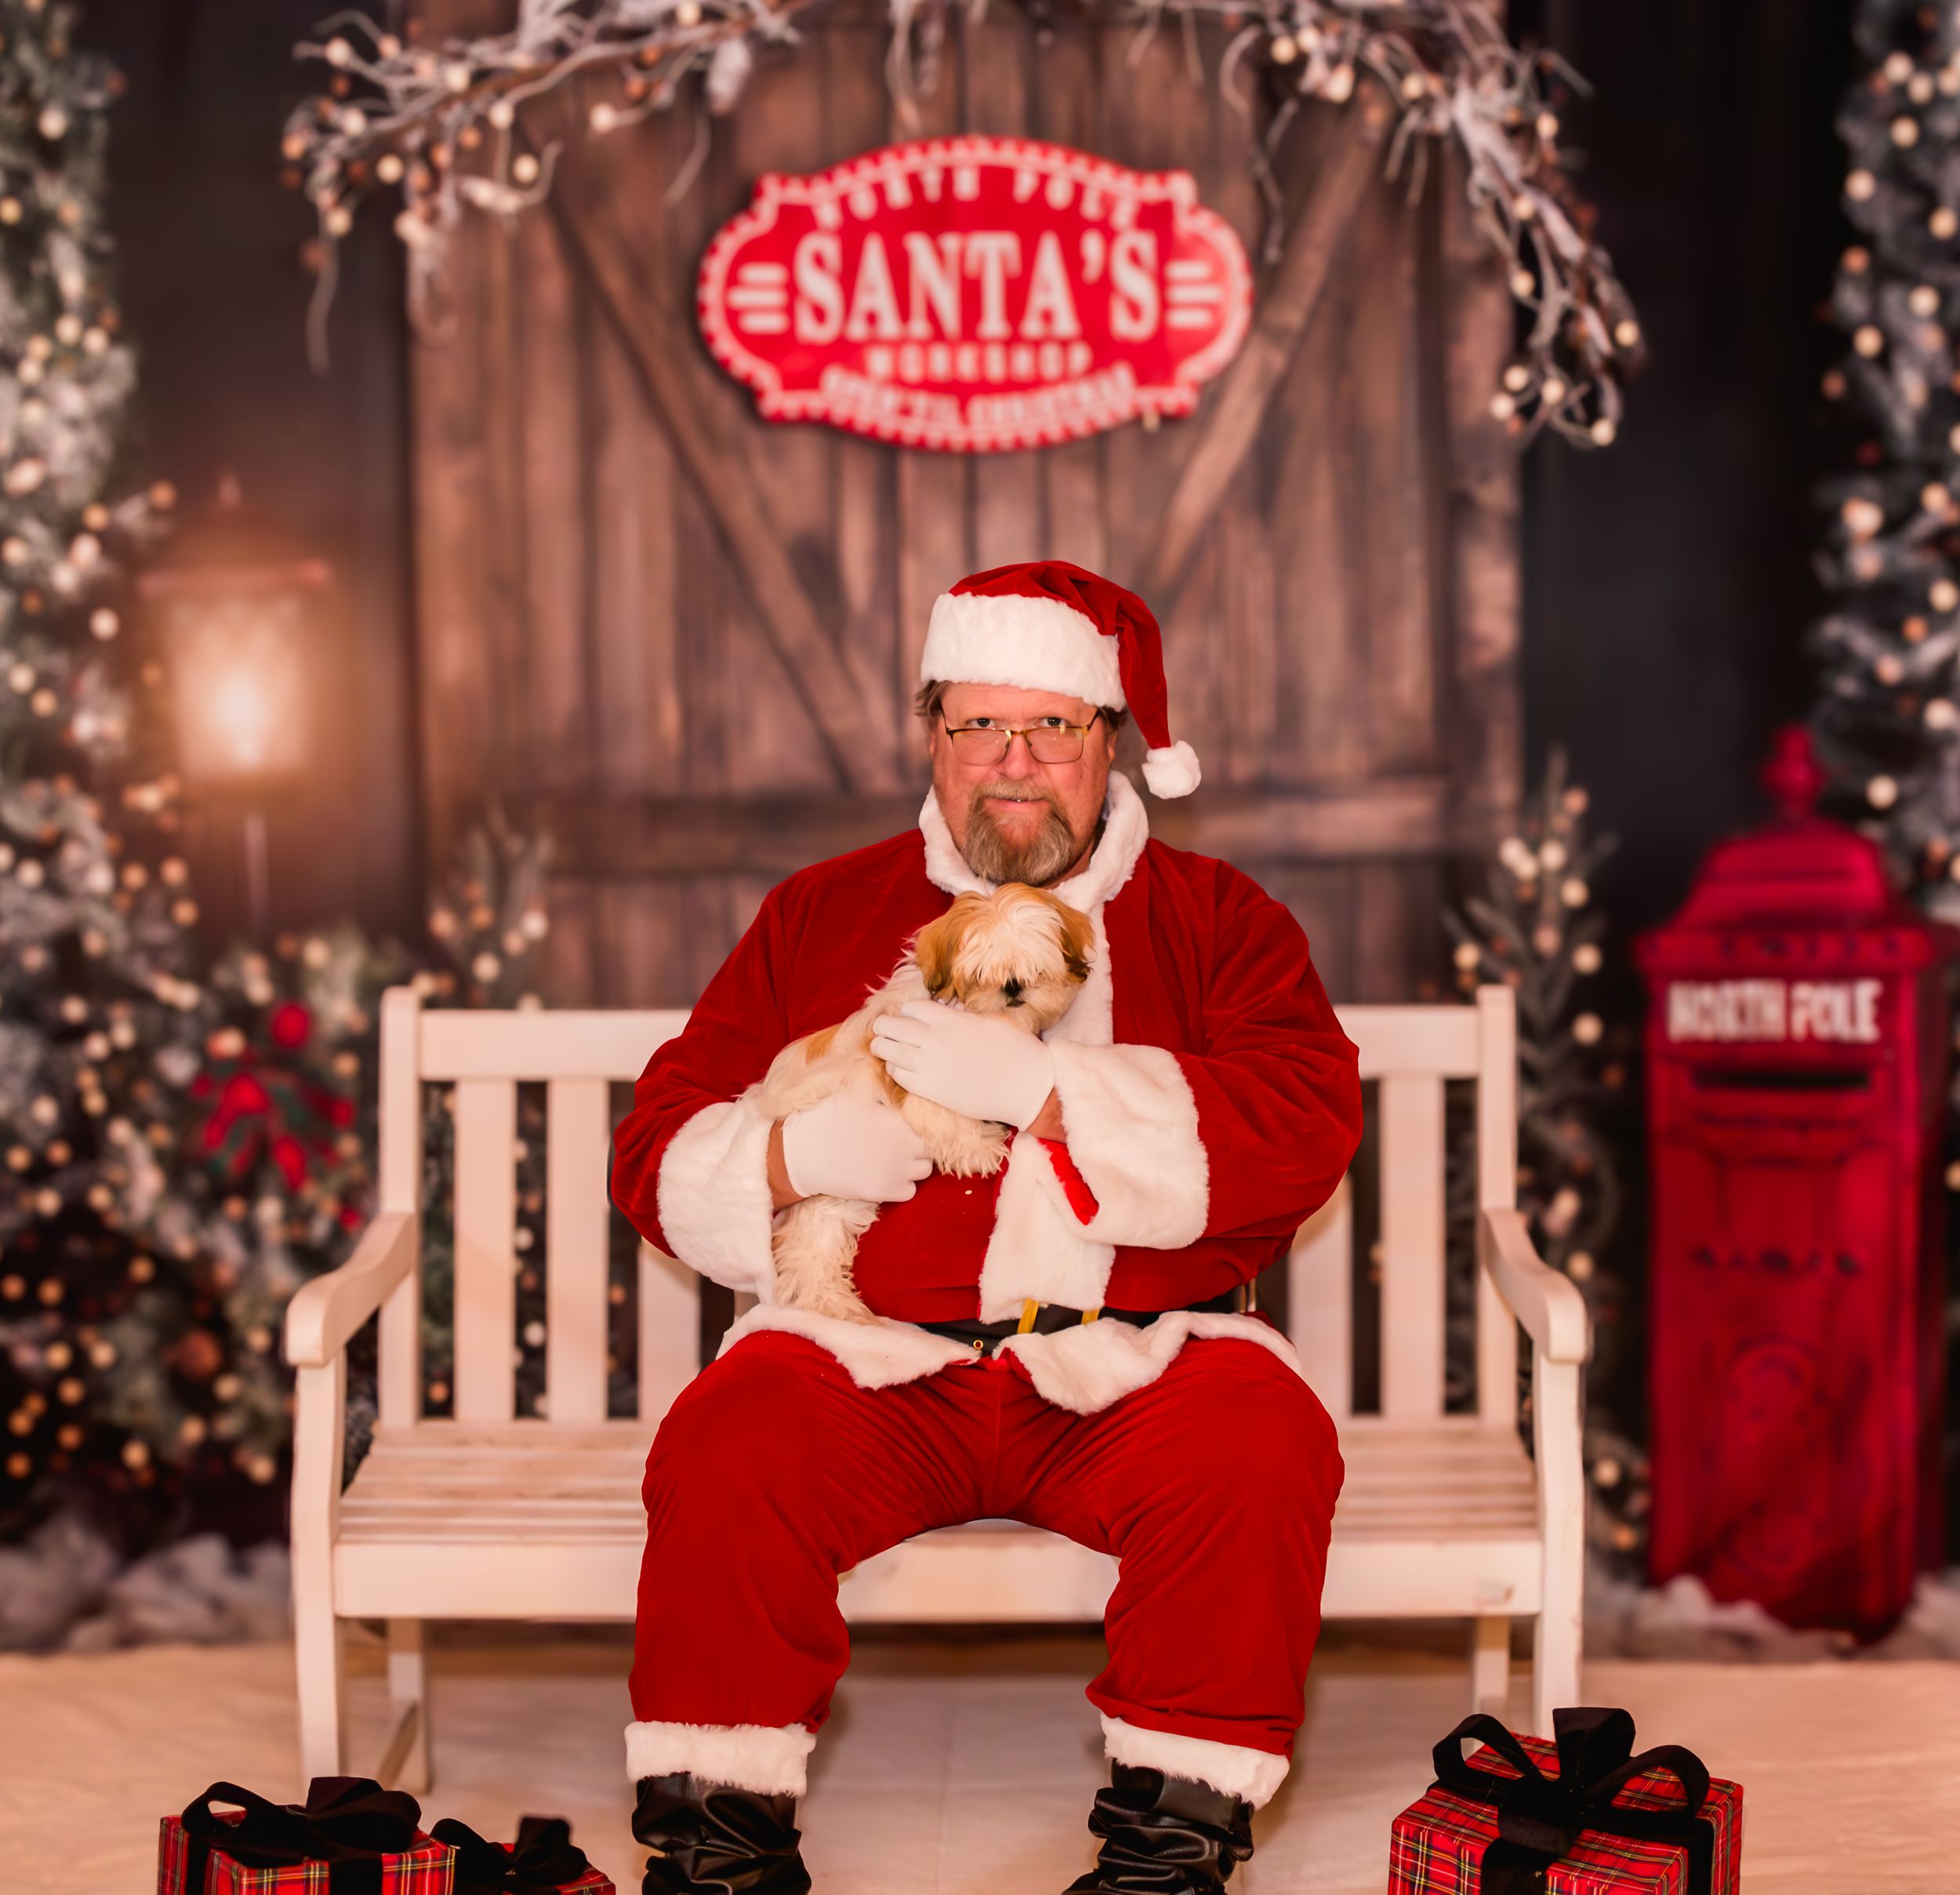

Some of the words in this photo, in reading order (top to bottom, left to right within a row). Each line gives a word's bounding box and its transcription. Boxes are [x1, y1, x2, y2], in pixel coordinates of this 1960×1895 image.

[793, 231, 1160, 343] SANTA'S
[863, 340, 1093, 383] WORKSHOP
[1668, 979, 1788, 1042] NORTH
[1791, 978, 1881, 1043] POLE
